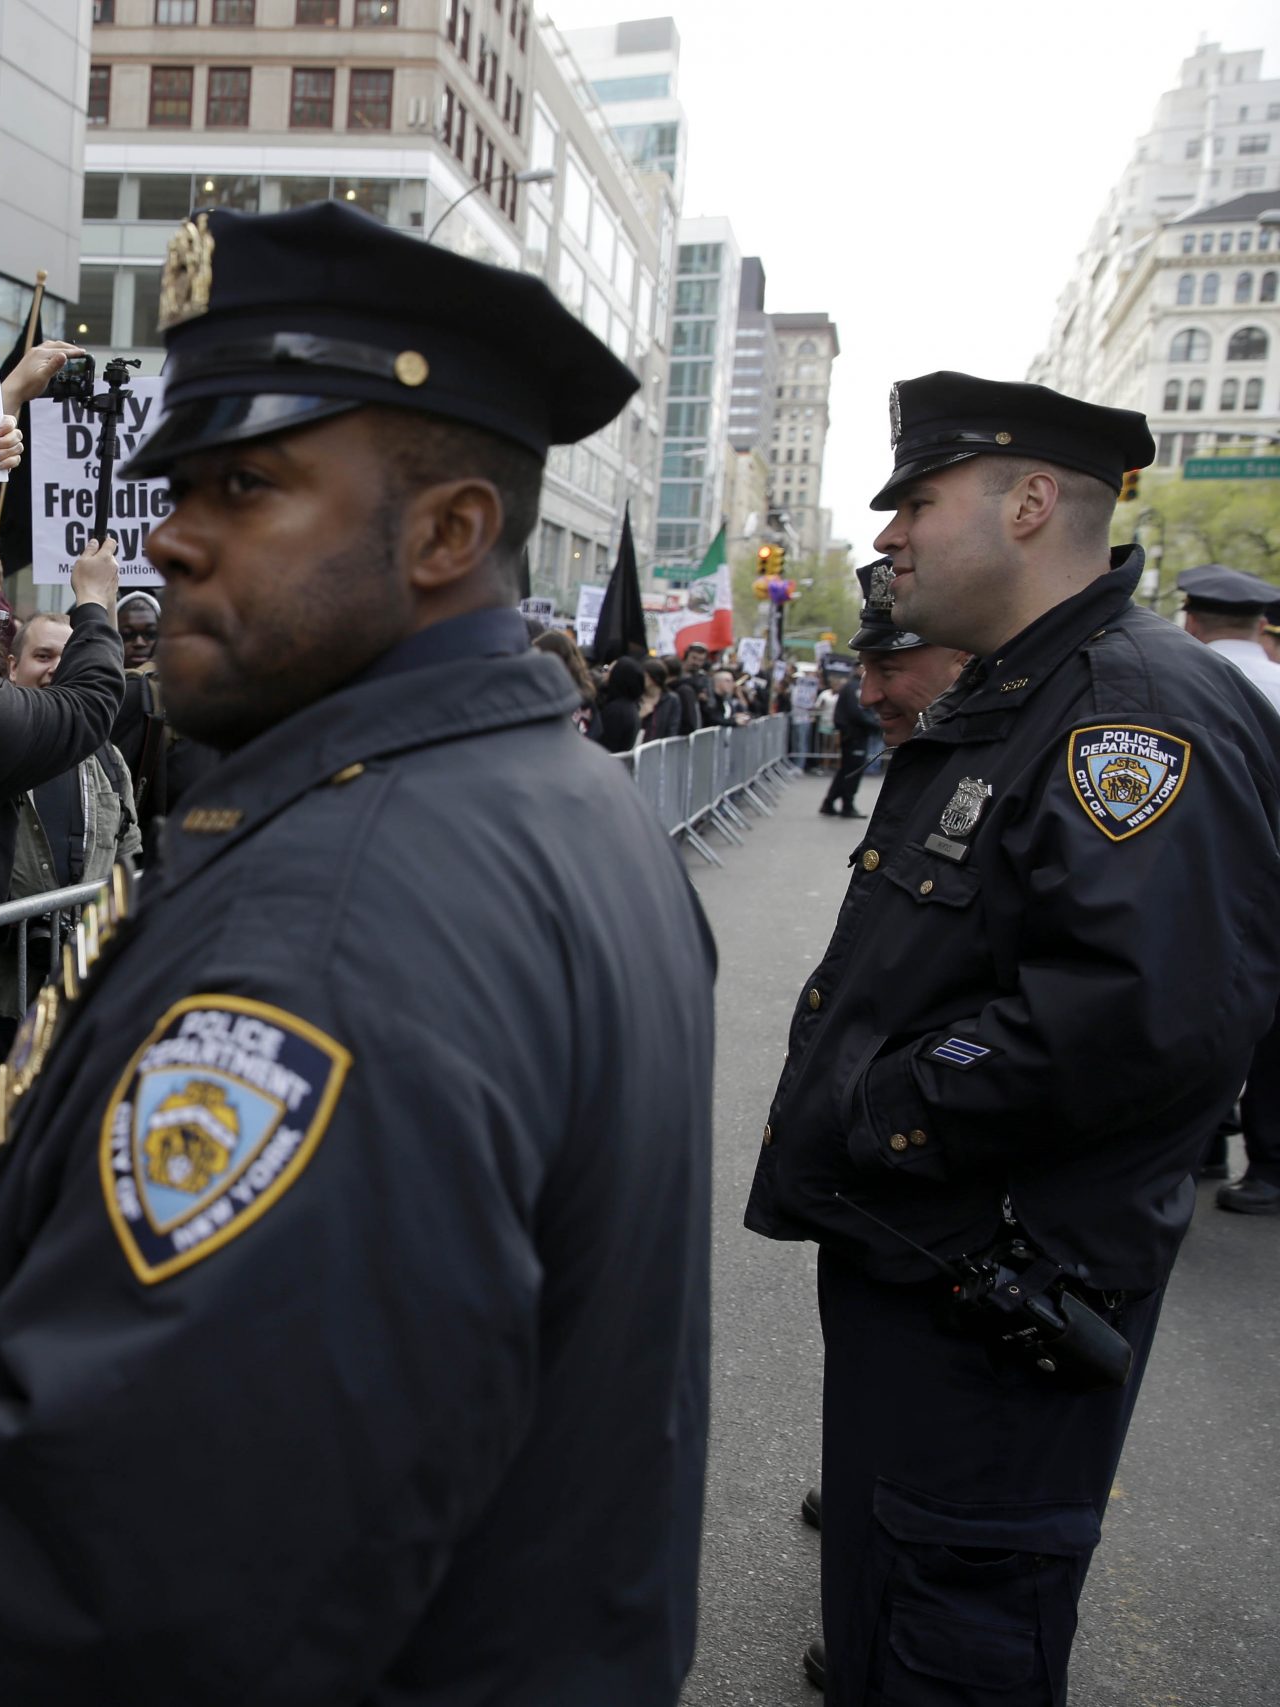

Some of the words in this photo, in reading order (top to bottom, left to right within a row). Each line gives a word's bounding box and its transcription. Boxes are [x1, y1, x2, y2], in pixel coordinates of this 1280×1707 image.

[62, 396, 153, 433] My
[116, 564, 156, 575] alition
[1080, 742, 1177, 767] DEPARTMENT
[1102, 731, 1159, 749] POLICE
[1076, 769, 1095, 798] CITY
[1089, 800, 1107, 818] OF
[1126, 804, 1155, 827] NEW
[1152, 774, 1179, 805] YORK
[178, 1010, 287, 1062] POLICE
[138, 1036, 313, 1112] DEPARTMENT
[171, 1198, 235, 1253] NEW
[229, 1125, 304, 1204] YORK
